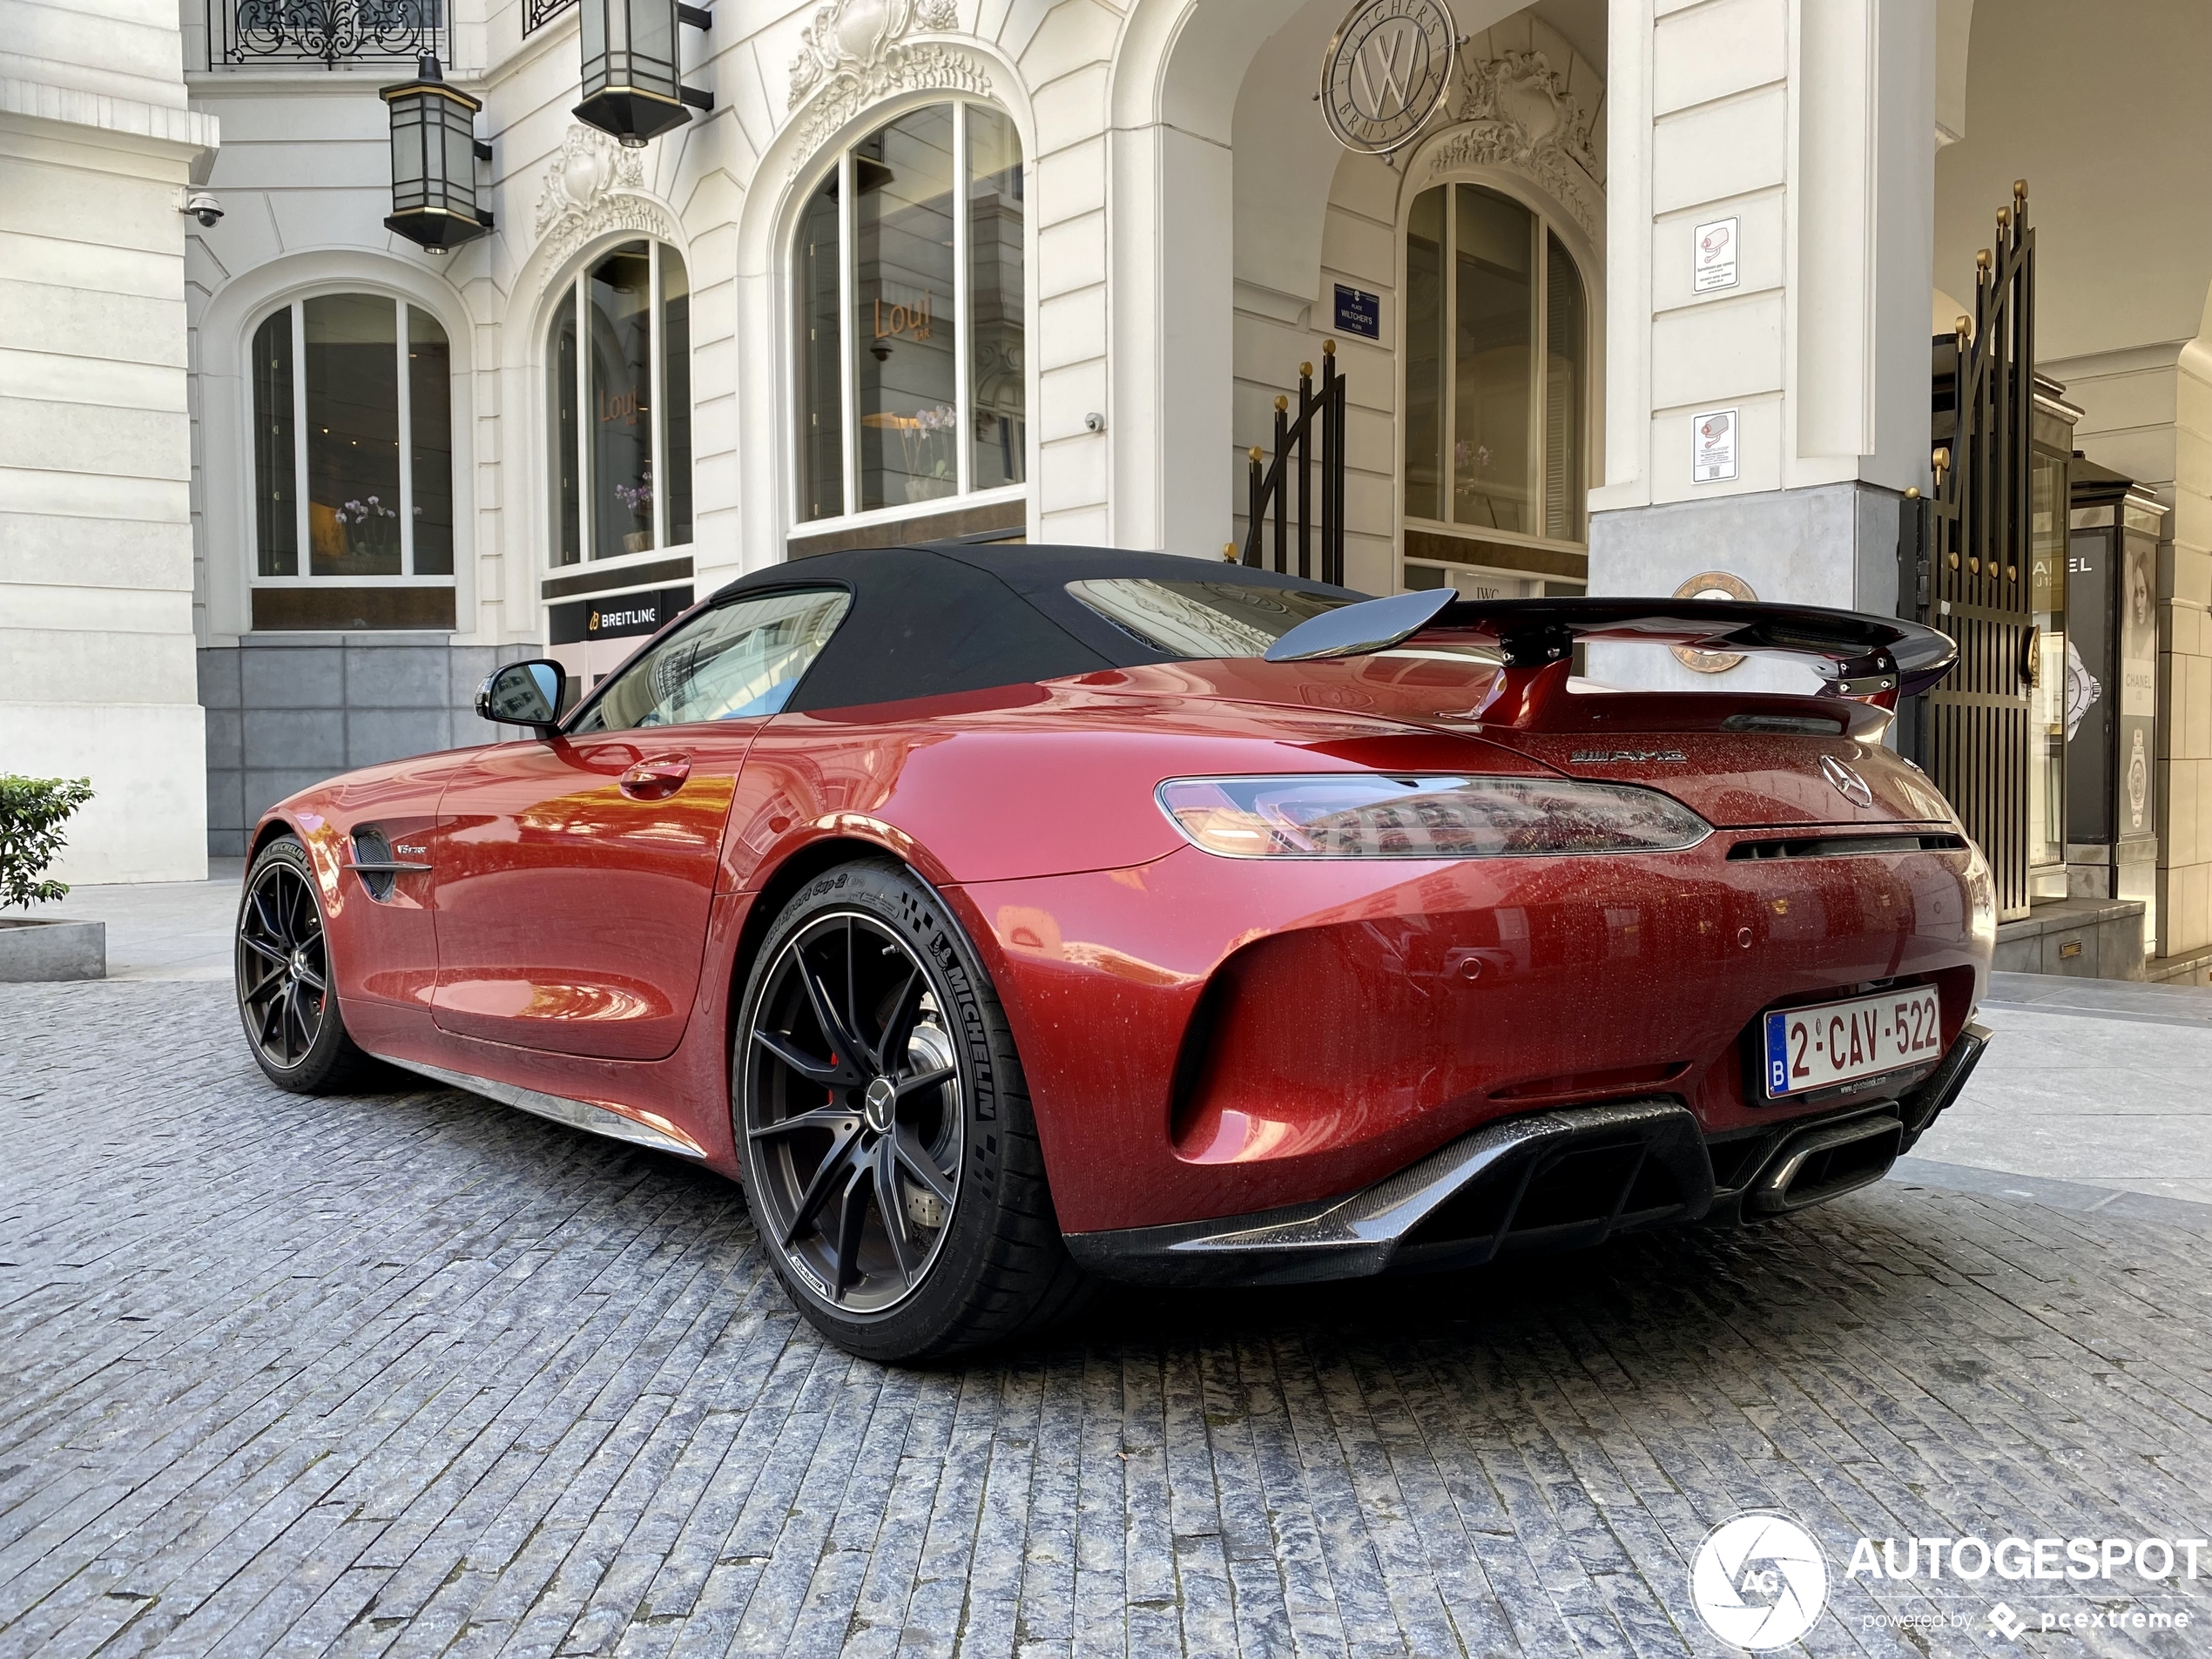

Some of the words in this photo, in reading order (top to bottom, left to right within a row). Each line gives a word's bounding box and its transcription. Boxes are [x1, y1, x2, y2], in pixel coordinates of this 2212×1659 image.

[1341, 309, 1372, 325] WILTCHER'S
[602, 608, 656, 628] BREITLING
[2126, 673, 2152, 690] CHANEL
[272, 842, 306, 861] MICHELIN
[781, 887, 812, 925] Sport
[813, 878, 835, 896] Cup
[834, 873, 848, 889] 2
[946, 965, 995, 1120] MICHELIN
[1772, 1060, 1784, 1086] B
